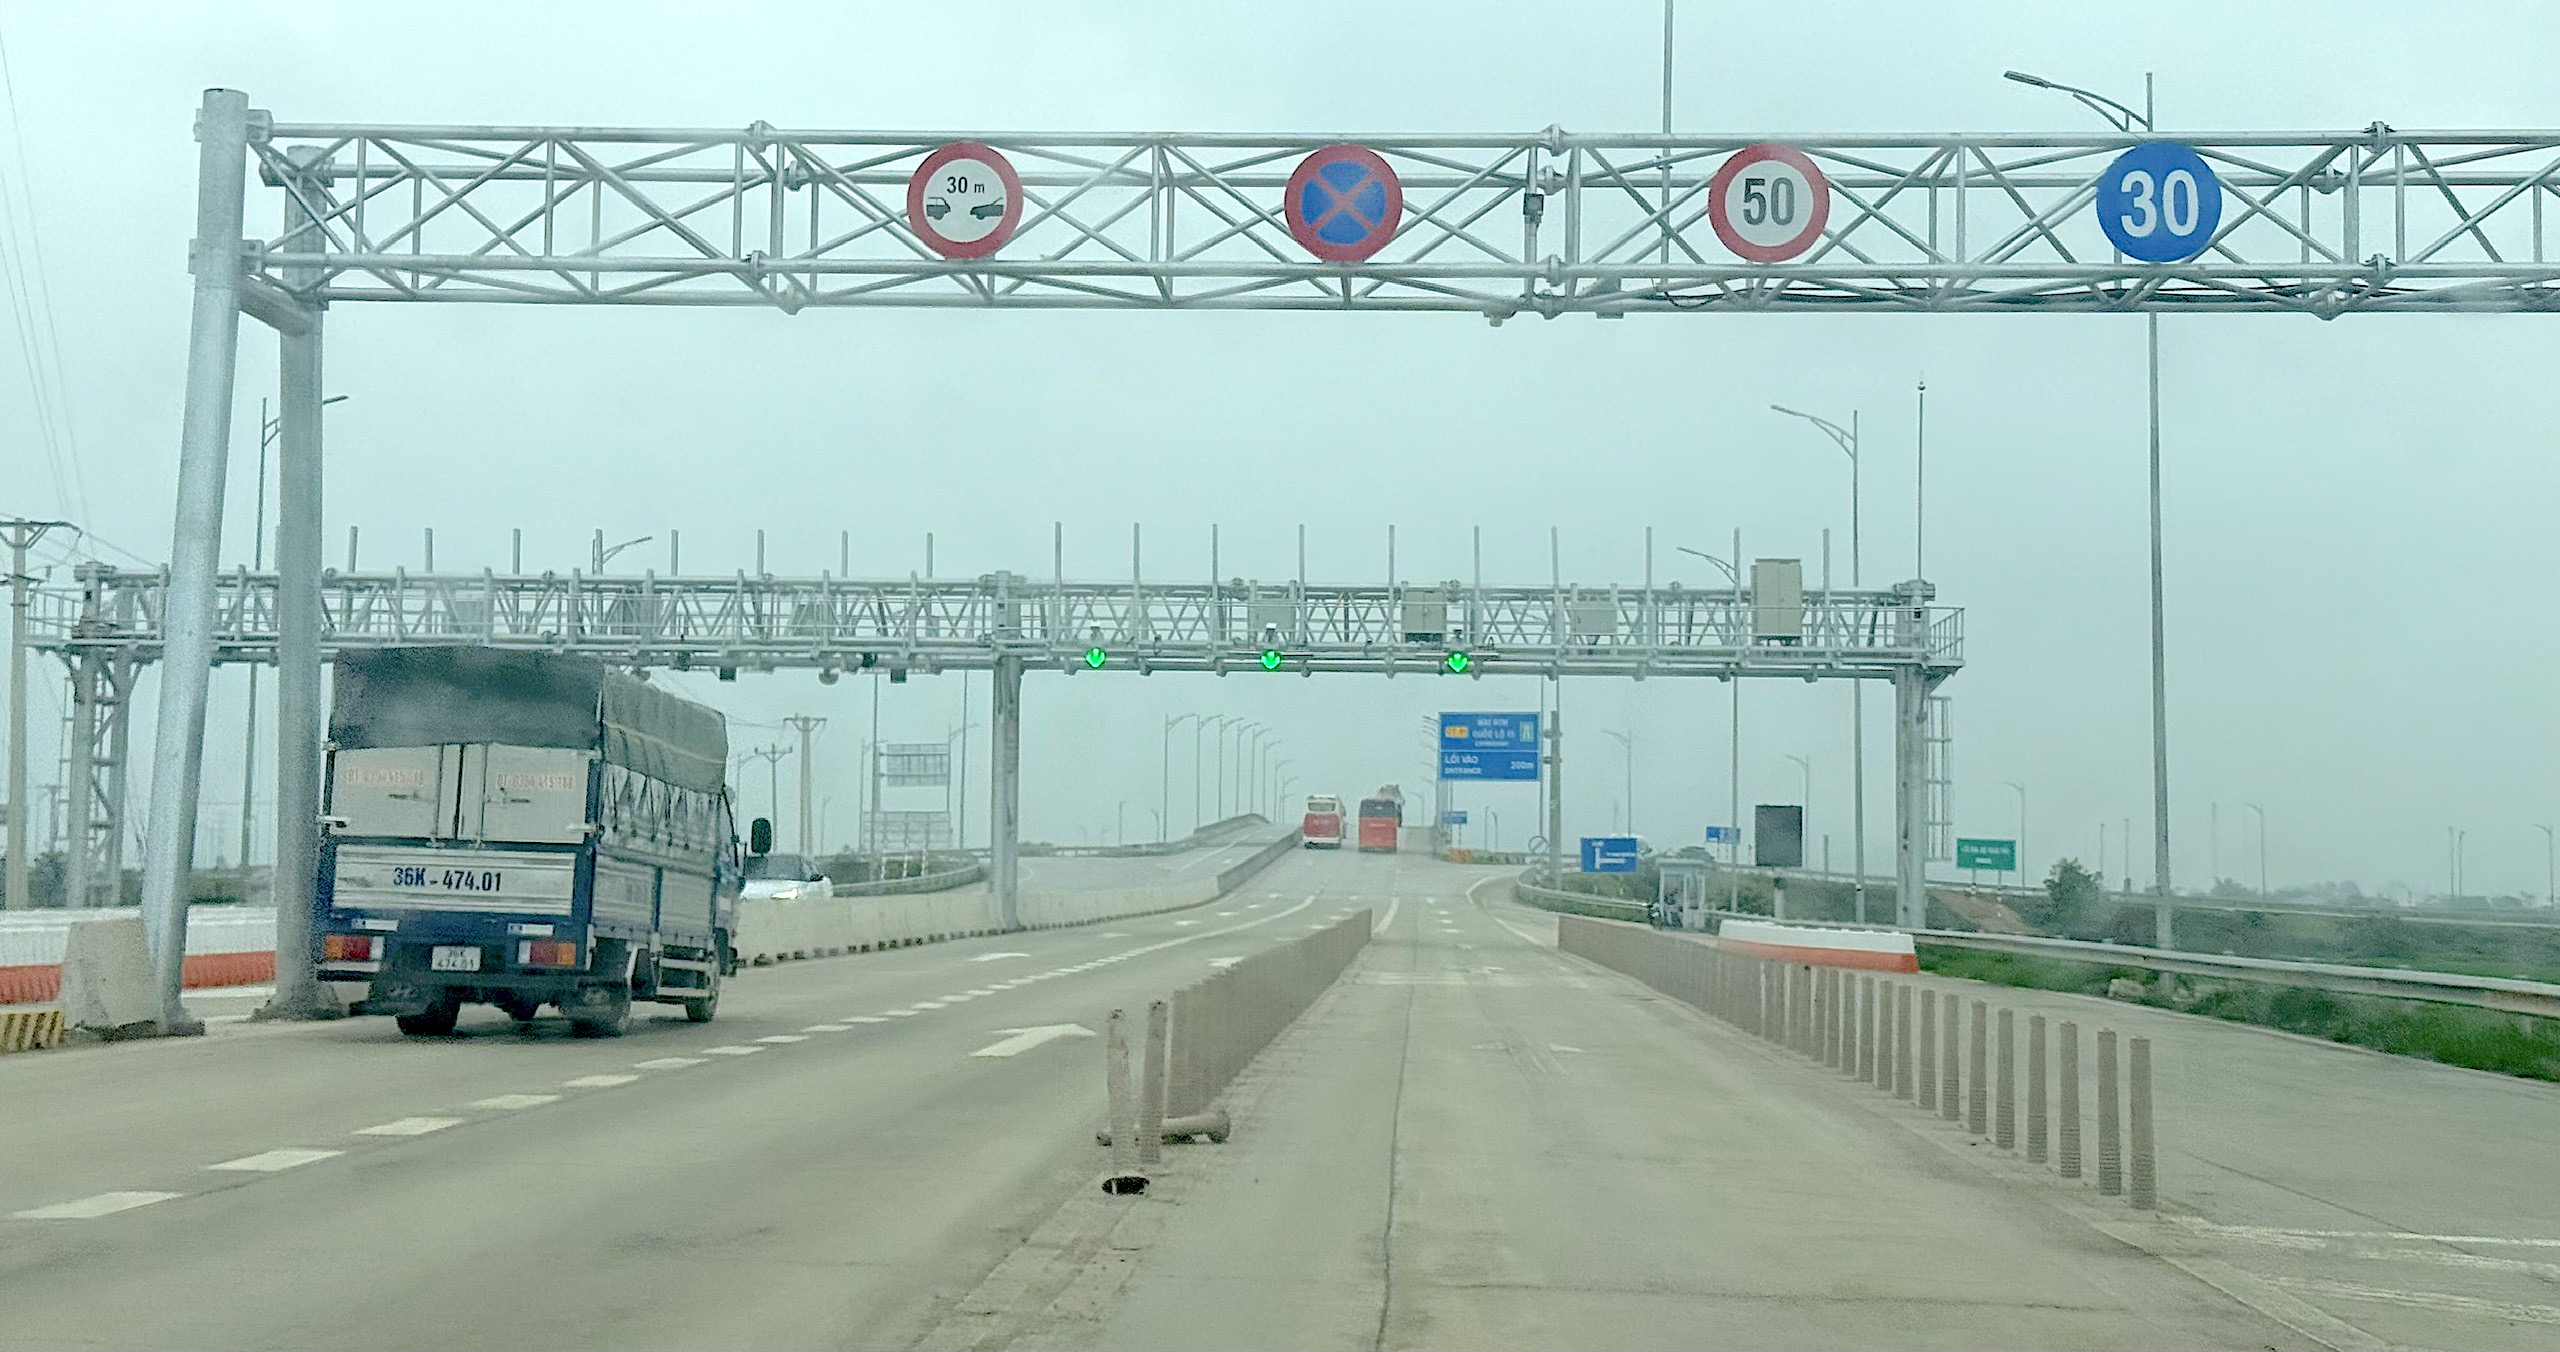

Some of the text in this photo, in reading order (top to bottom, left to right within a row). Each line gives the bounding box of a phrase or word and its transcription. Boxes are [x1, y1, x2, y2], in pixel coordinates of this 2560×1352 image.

[947, 176, 985, 194] 30 m
[1743, 177, 1795, 226] 50
[2121, 169, 2199, 237] 30
[393, 867, 426, 887] 36K
[443, 870, 502, 892] 474.01
